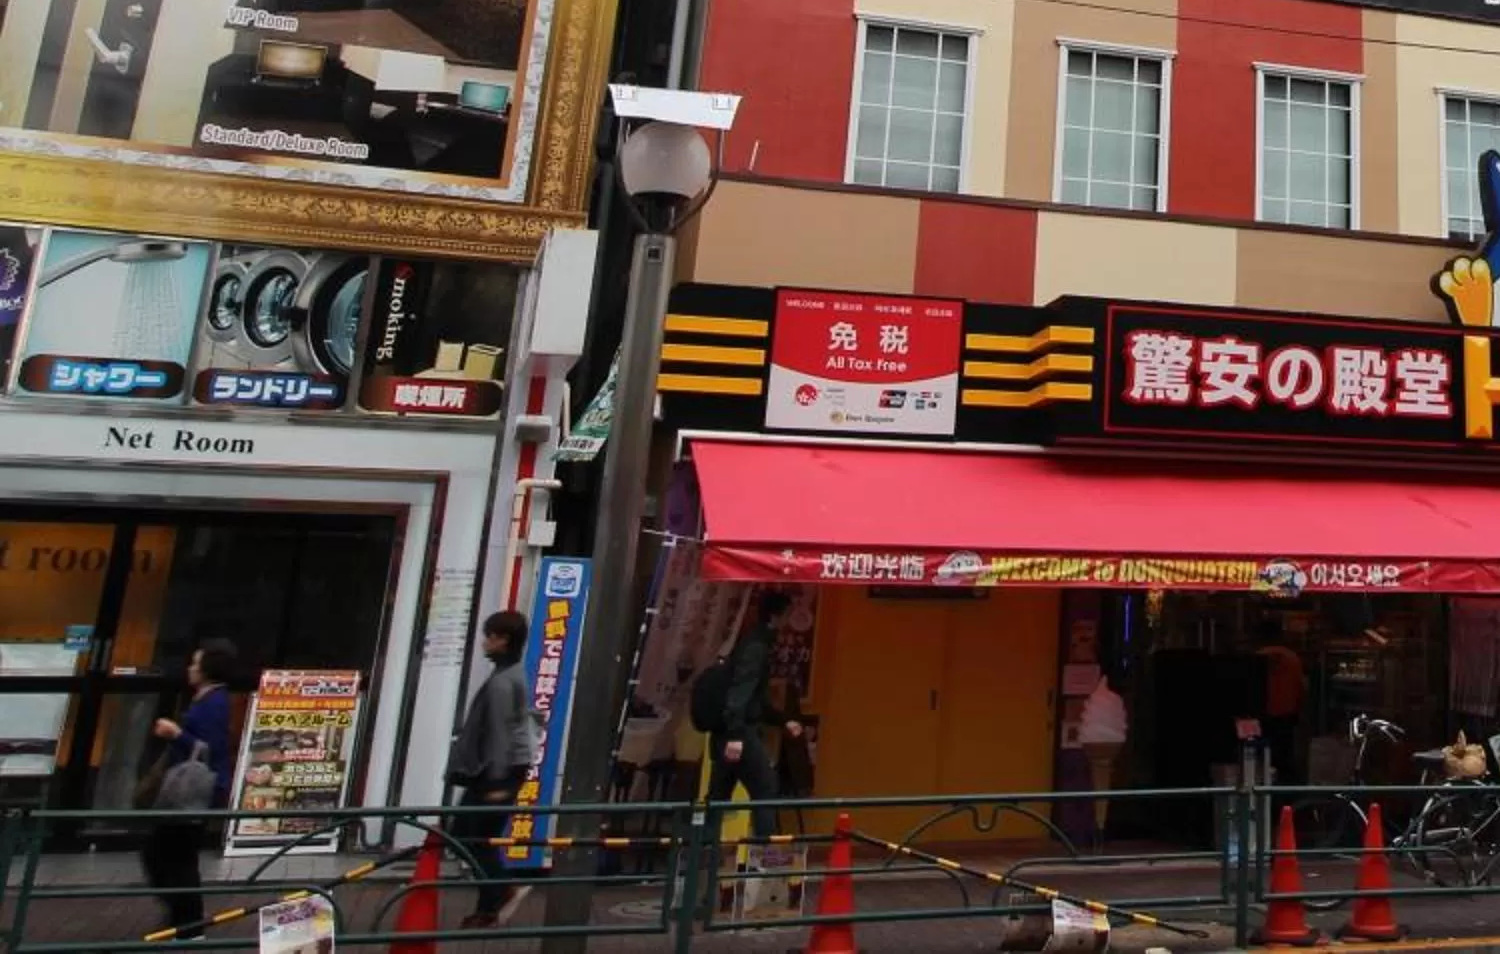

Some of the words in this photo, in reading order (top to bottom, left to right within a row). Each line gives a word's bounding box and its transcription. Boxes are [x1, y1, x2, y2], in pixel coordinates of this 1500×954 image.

[228, 7, 254, 26] VIP
[255, 10, 298, 32] Room
[327, 137, 369, 159] Room
[828, 321, 909, 355] 免税
[54, 363, 163, 390] シャワー
[826, 356, 846, 370] All
[848, 359, 872, 371] Tax
[877, 361, 907, 373] Free
[1130, 331, 1453, 418] 驚安の殿堂
[212, 375, 334, 400] ランドリー
[105, 426, 153, 449] Net
[173, 428, 255, 454] Room
